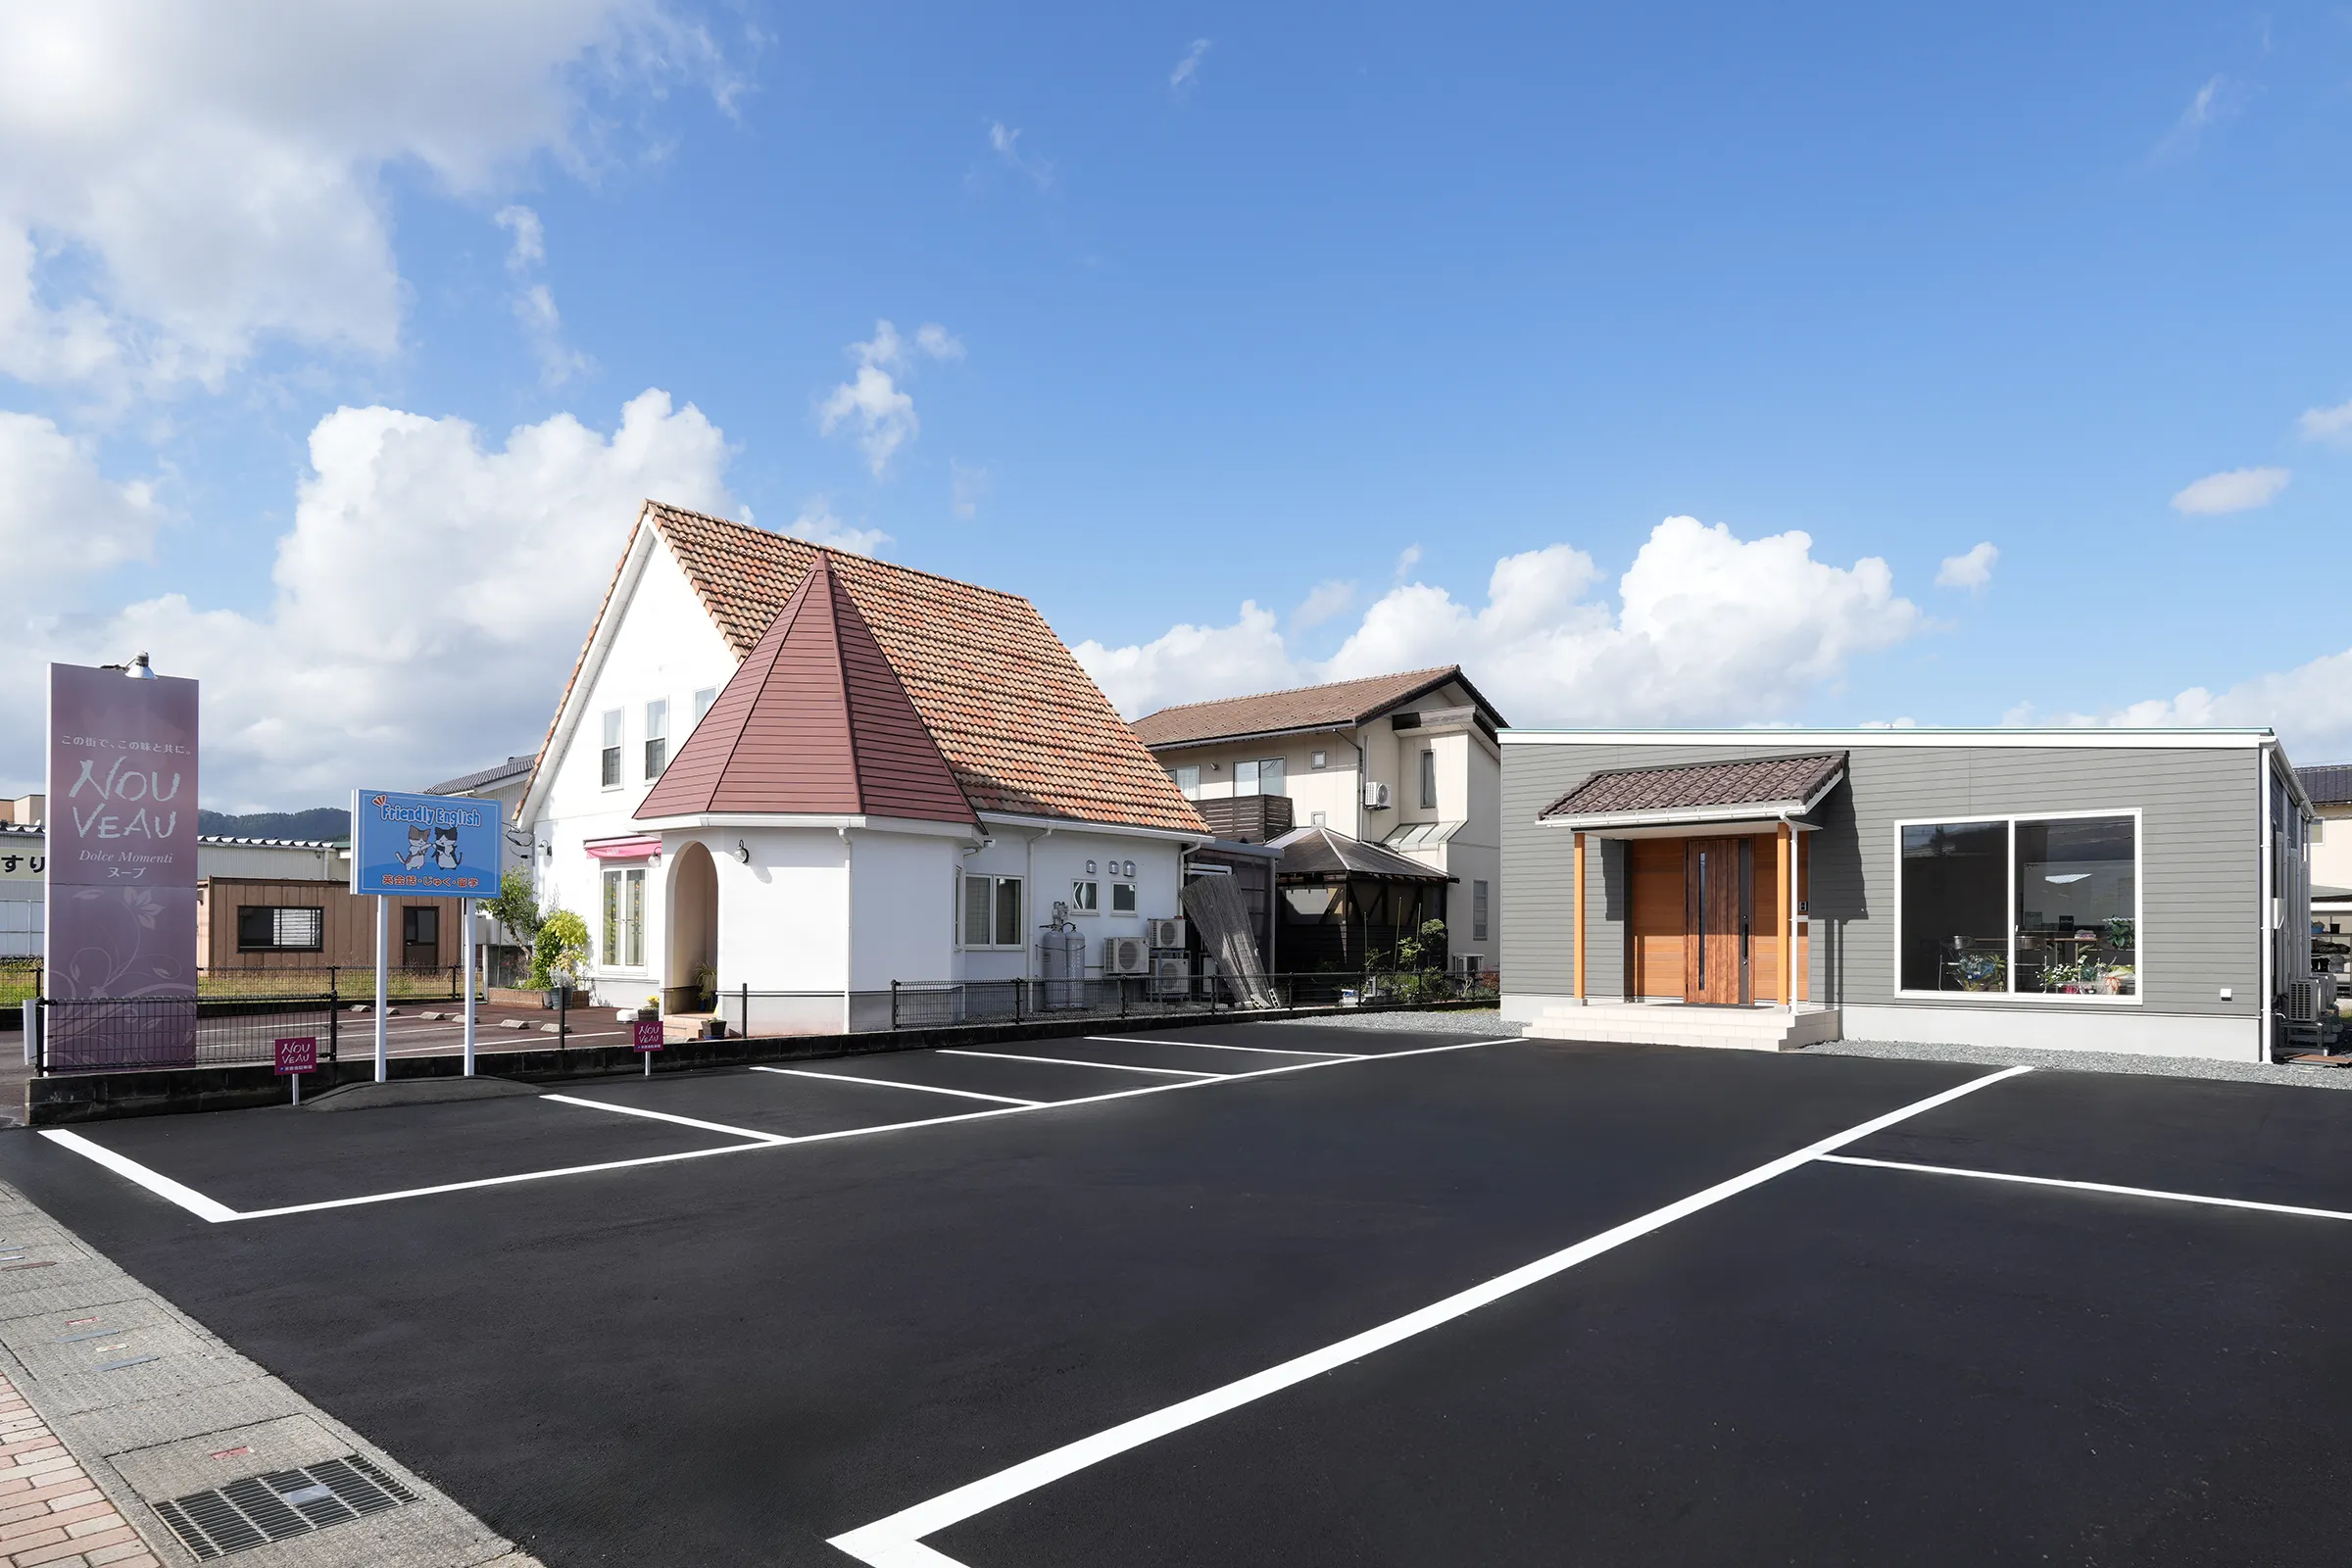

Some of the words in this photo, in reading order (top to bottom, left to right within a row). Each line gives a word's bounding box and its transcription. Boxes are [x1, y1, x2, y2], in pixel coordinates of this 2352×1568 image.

[62, 735, 191, 756] この街で、この味と共に。
[69, 756, 181, 802] NOU
[73, 803, 177, 839] VEAU
[380, 804, 436, 826] Friendly
[436, 807, 481, 827] English
[1, 855, 45, 873] すり
[79, 850, 115, 861] Dolce
[118, 851, 173, 863] Momenti
[639, 1024, 660, 1035] NOU
[281, 1041, 311, 1054] NOU
[281, 1054, 310, 1064] VEAU
